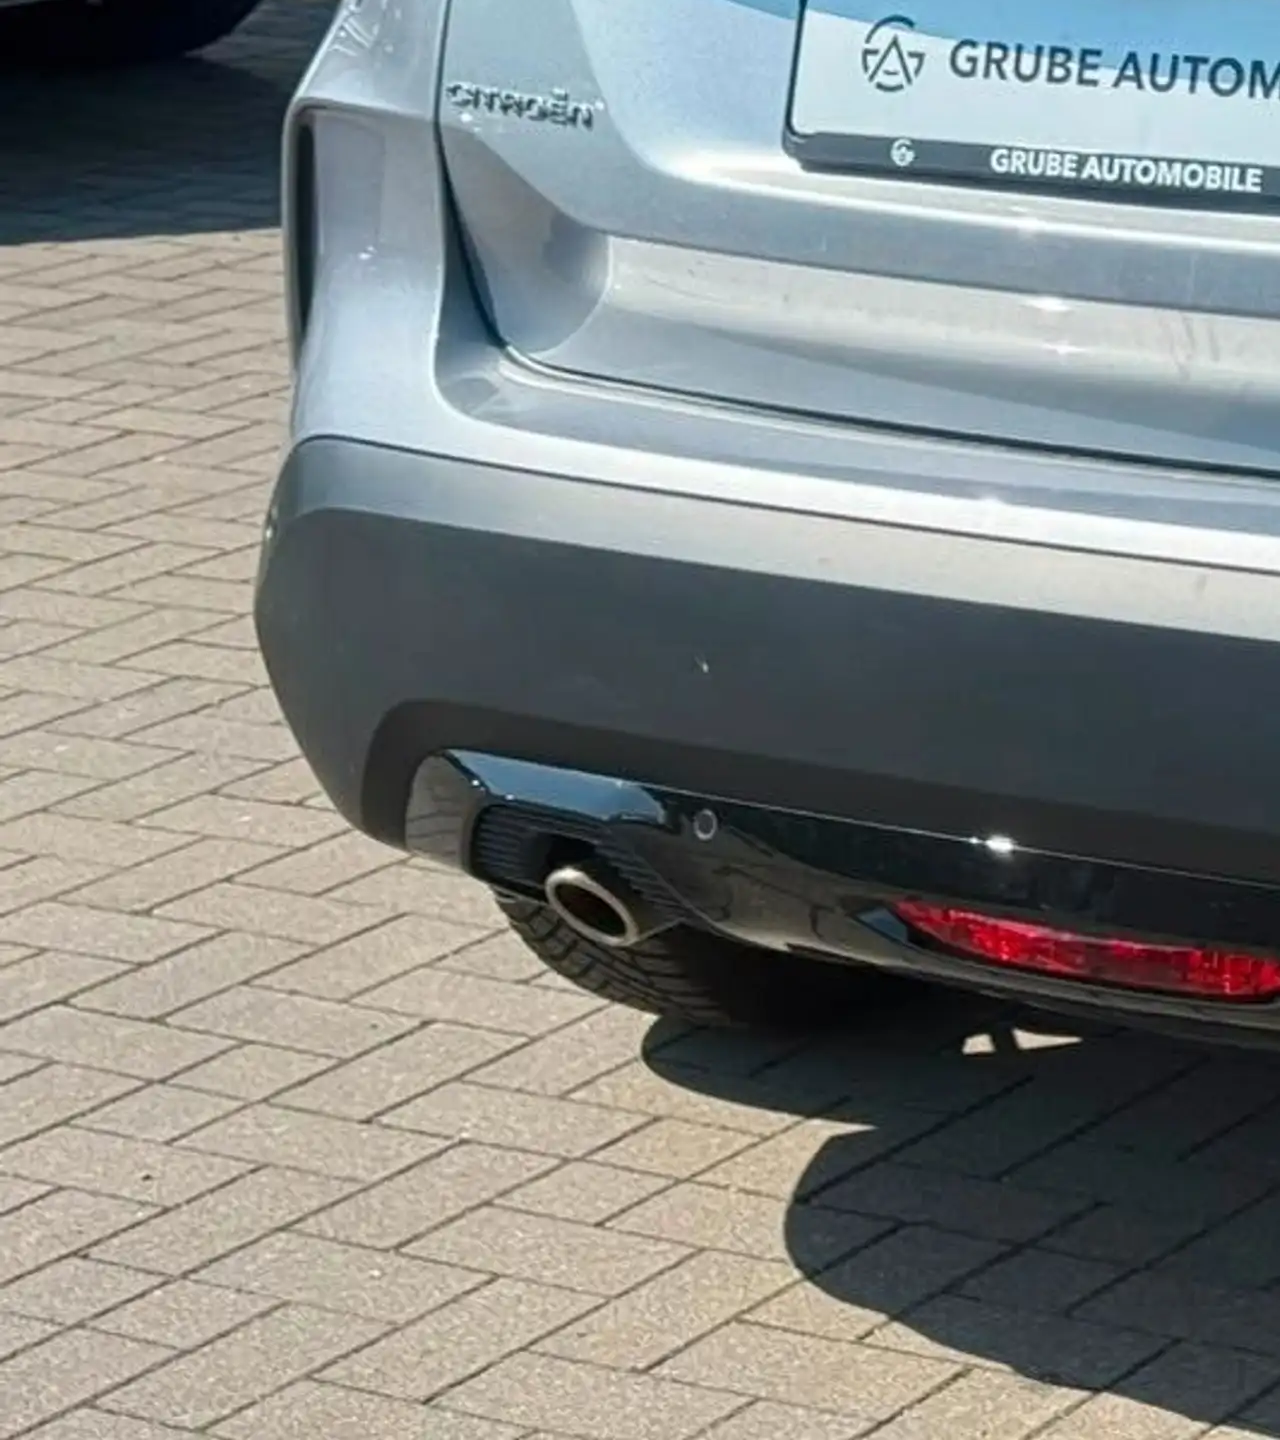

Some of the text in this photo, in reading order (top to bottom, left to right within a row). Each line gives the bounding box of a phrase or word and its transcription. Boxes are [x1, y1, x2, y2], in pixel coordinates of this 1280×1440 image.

[950, 39, 1103, 87] GRUBE
[990, 147, 1264, 194] GRUBE AUTOMOBILE
